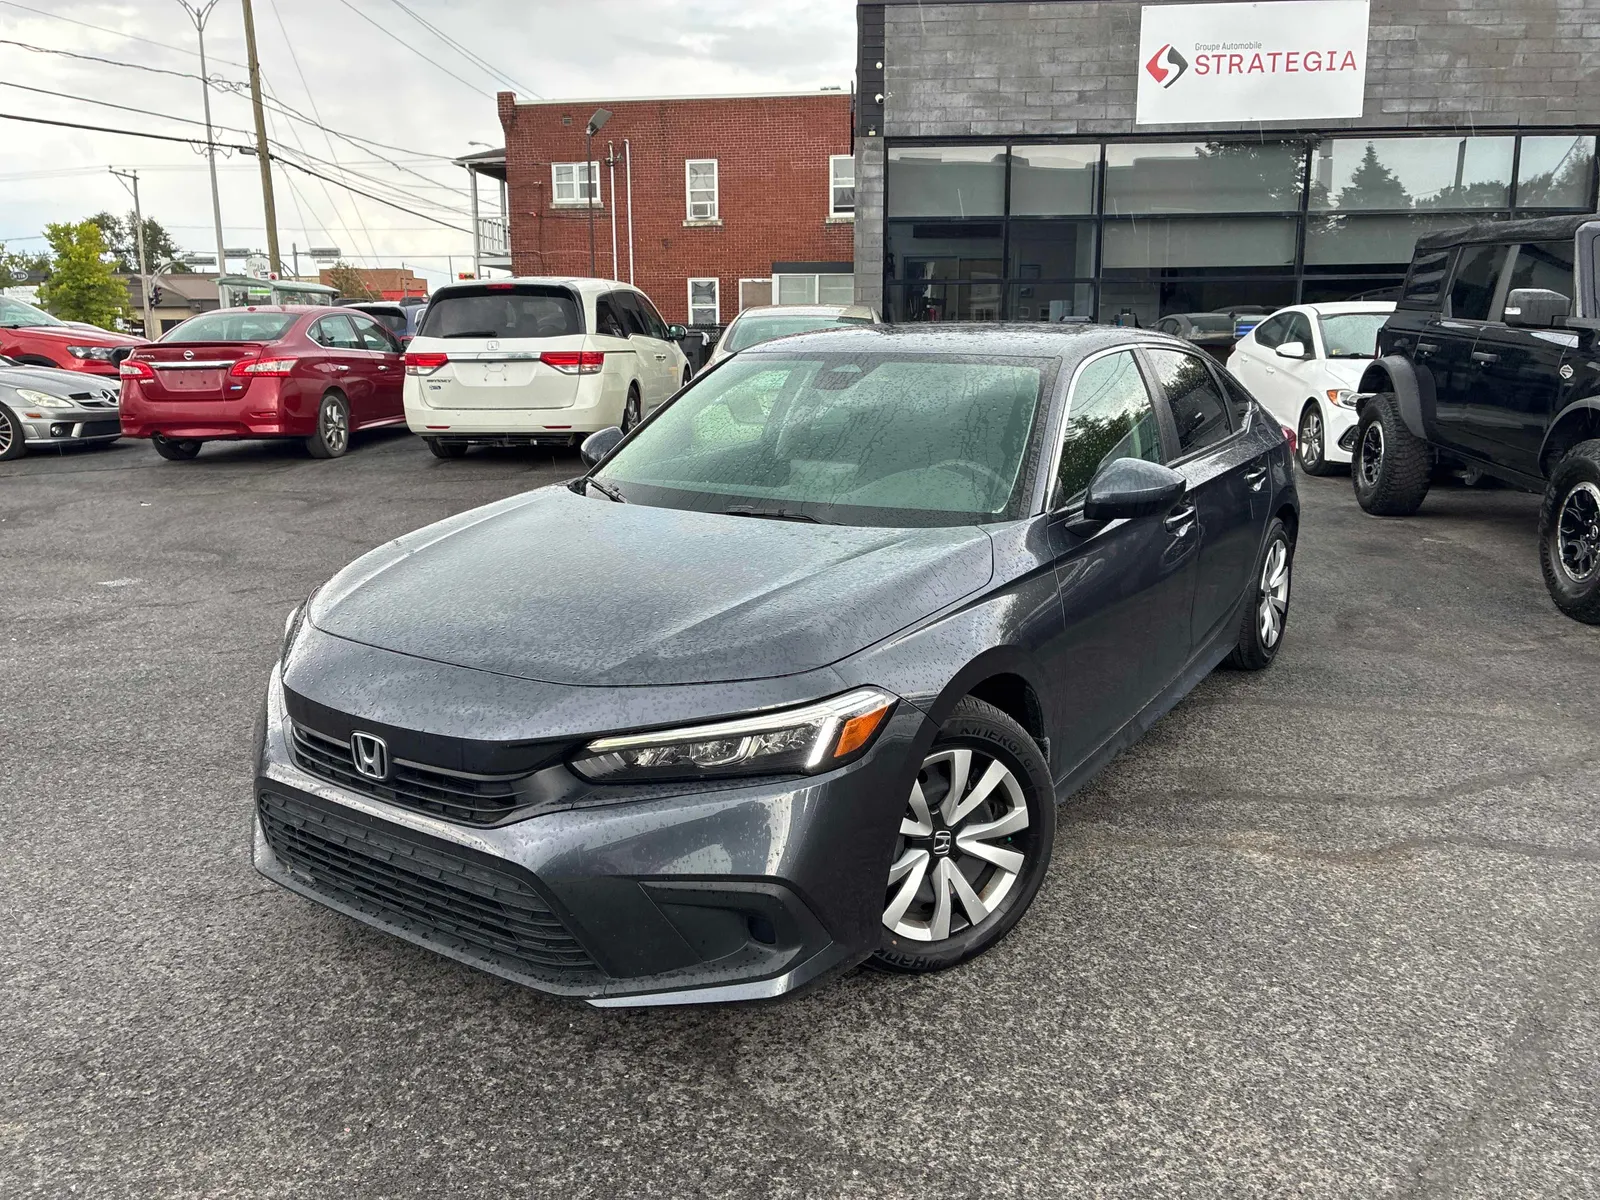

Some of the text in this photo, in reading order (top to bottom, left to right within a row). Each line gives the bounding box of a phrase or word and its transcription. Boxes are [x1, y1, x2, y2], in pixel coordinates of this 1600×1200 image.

[1194, 41, 1263, 52] Groupe Automobile
[1194, 50, 1358, 75] STRATEGIA
[960, 727, 1027, 756] KINERGY
